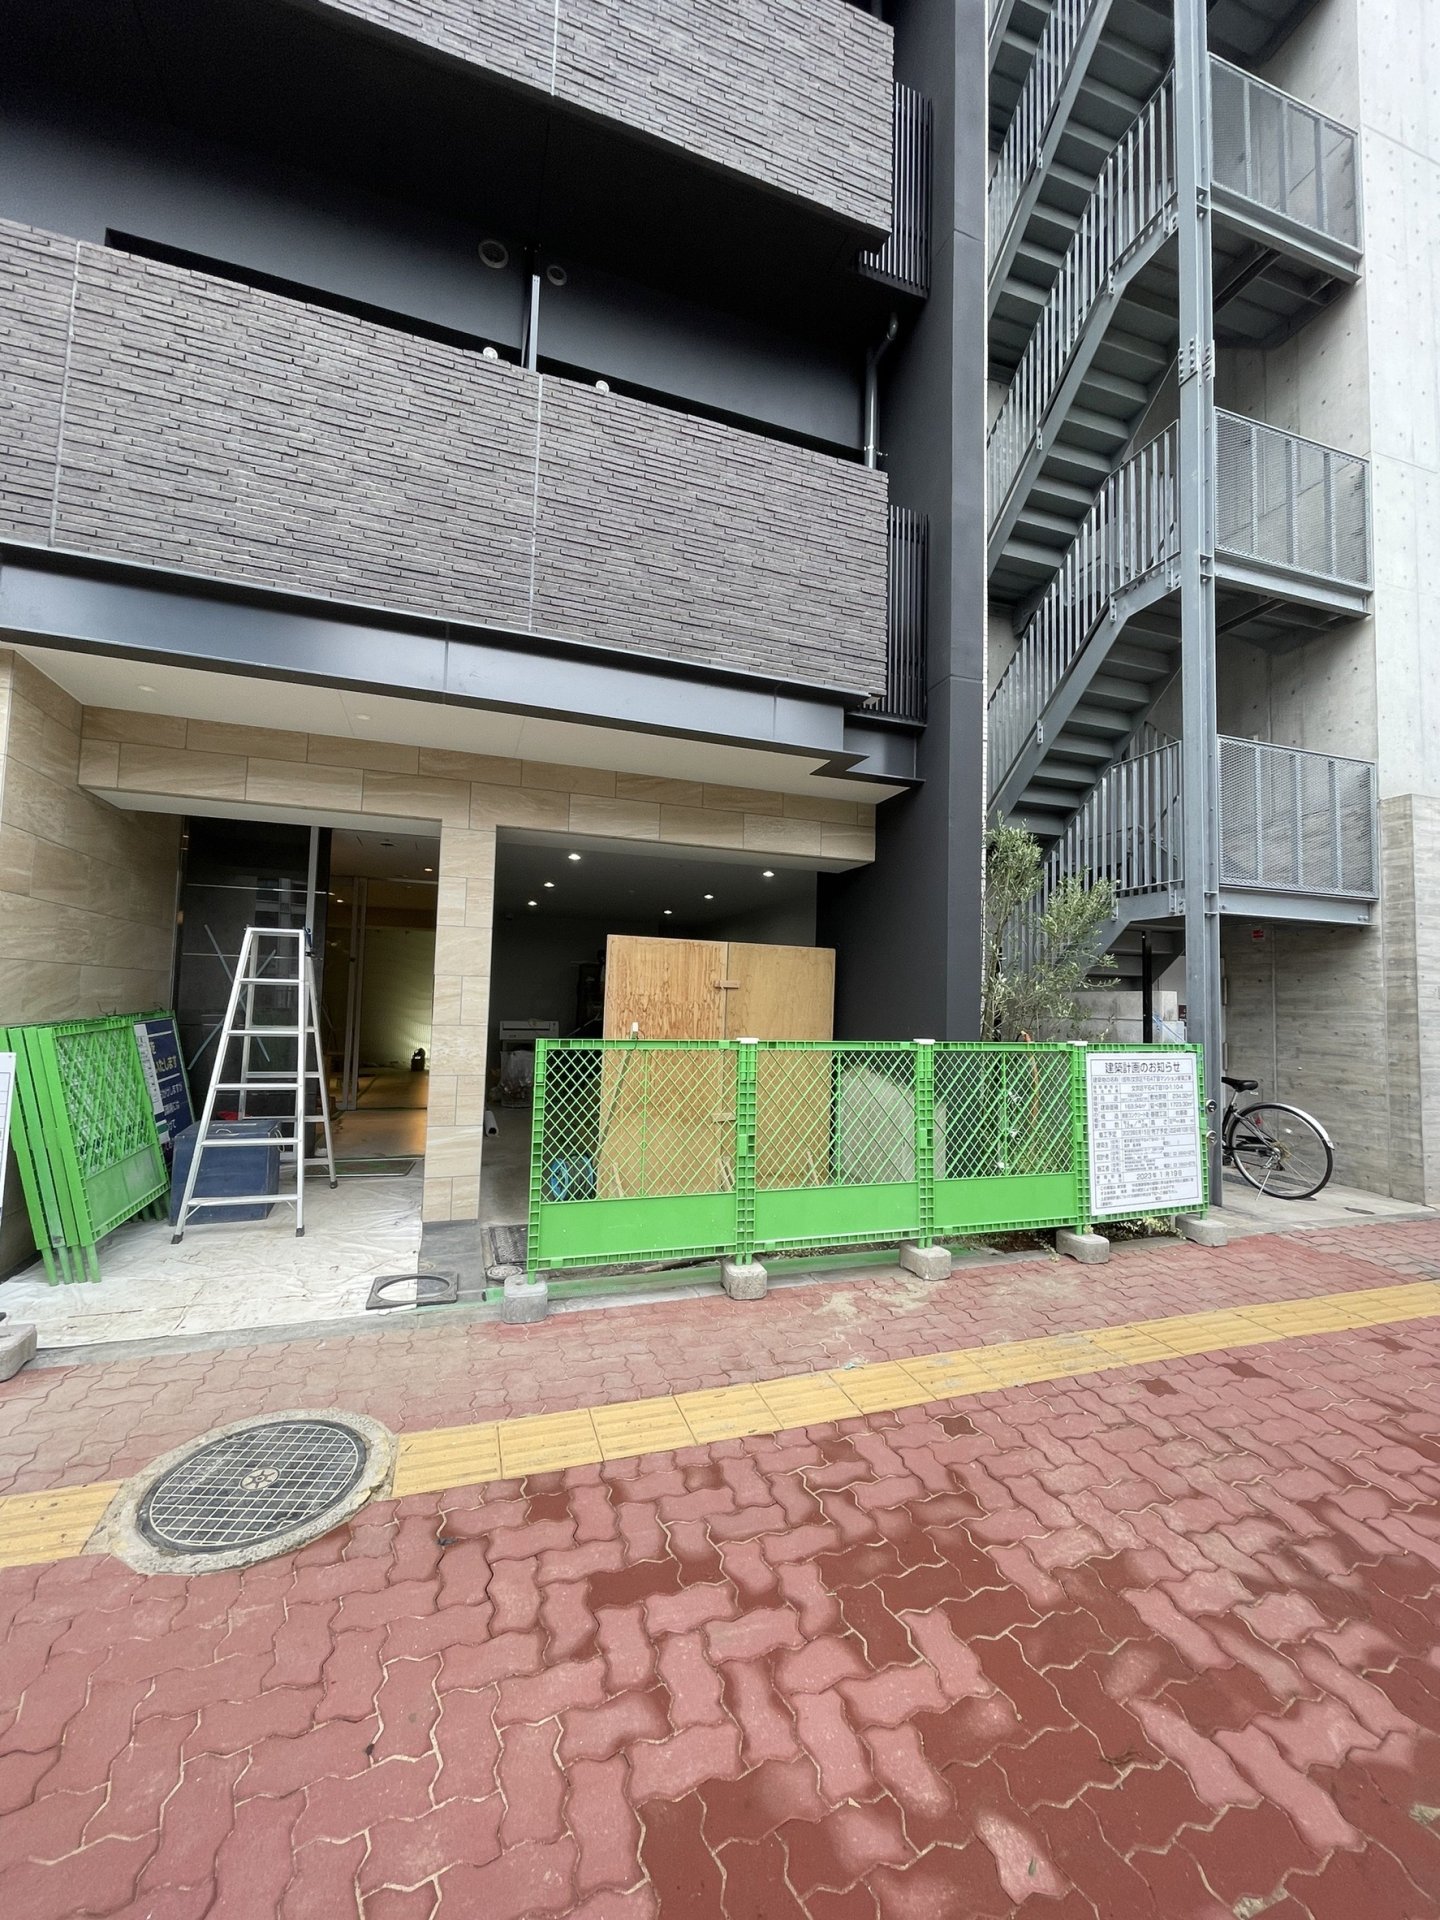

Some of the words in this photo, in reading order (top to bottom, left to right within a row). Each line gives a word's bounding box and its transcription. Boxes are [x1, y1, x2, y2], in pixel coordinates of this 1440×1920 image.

[1104, 1061, 1181, 1074] 建築計画のお知らせ
